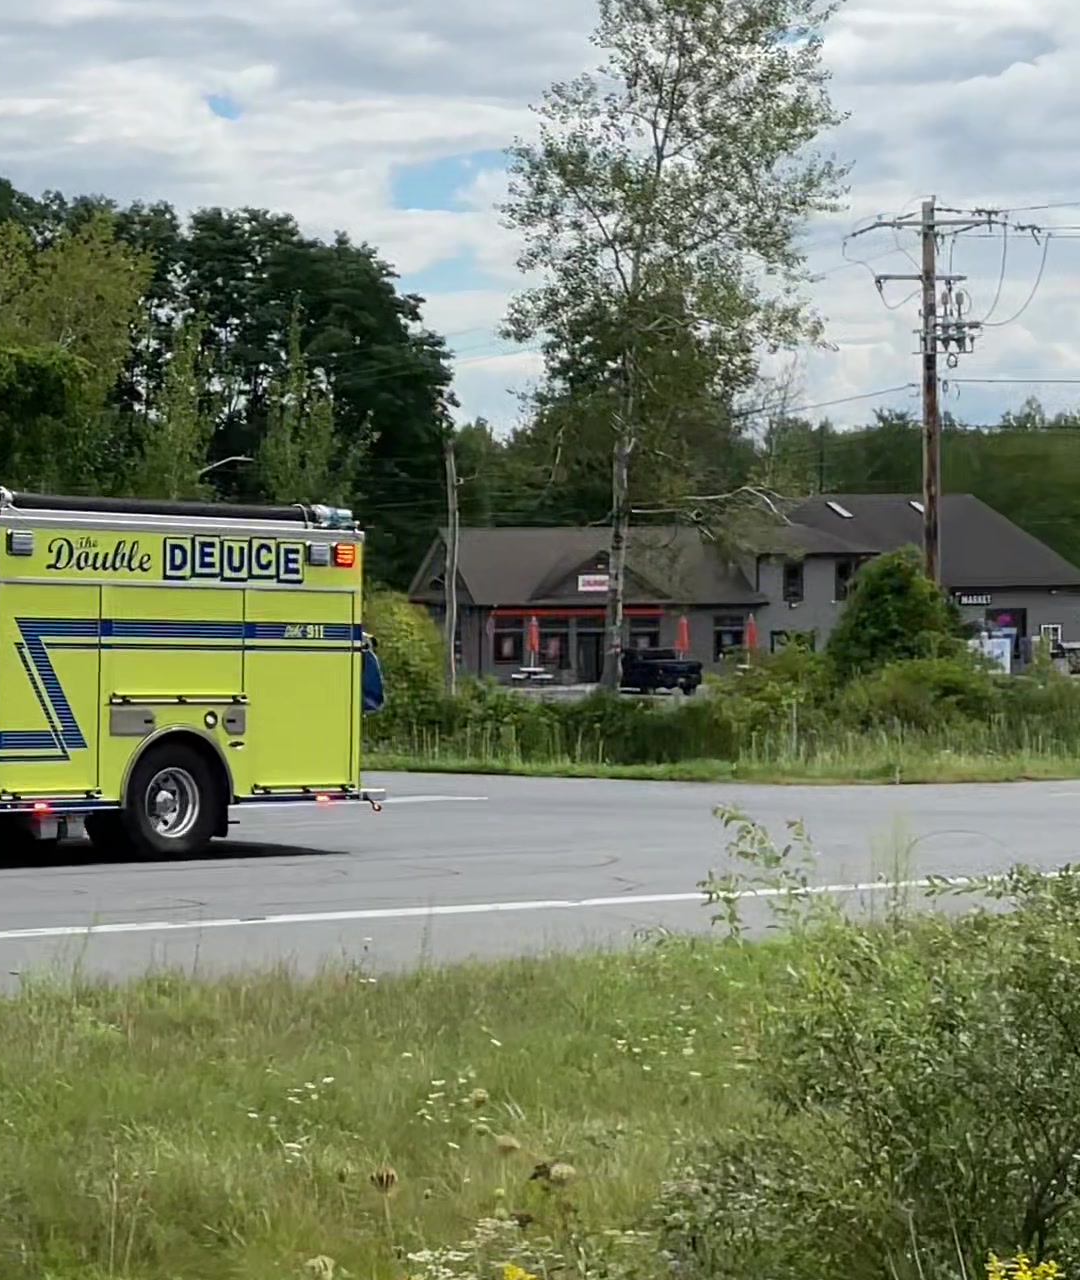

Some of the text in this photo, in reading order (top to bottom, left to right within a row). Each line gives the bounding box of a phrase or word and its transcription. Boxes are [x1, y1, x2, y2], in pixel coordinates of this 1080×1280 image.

[77, 536, 99, 549] The
[46, 537, 301, 576] Double DEUCE
[960, 595, 992, 604] MARKET
[306, 624, 324, 639] 911
